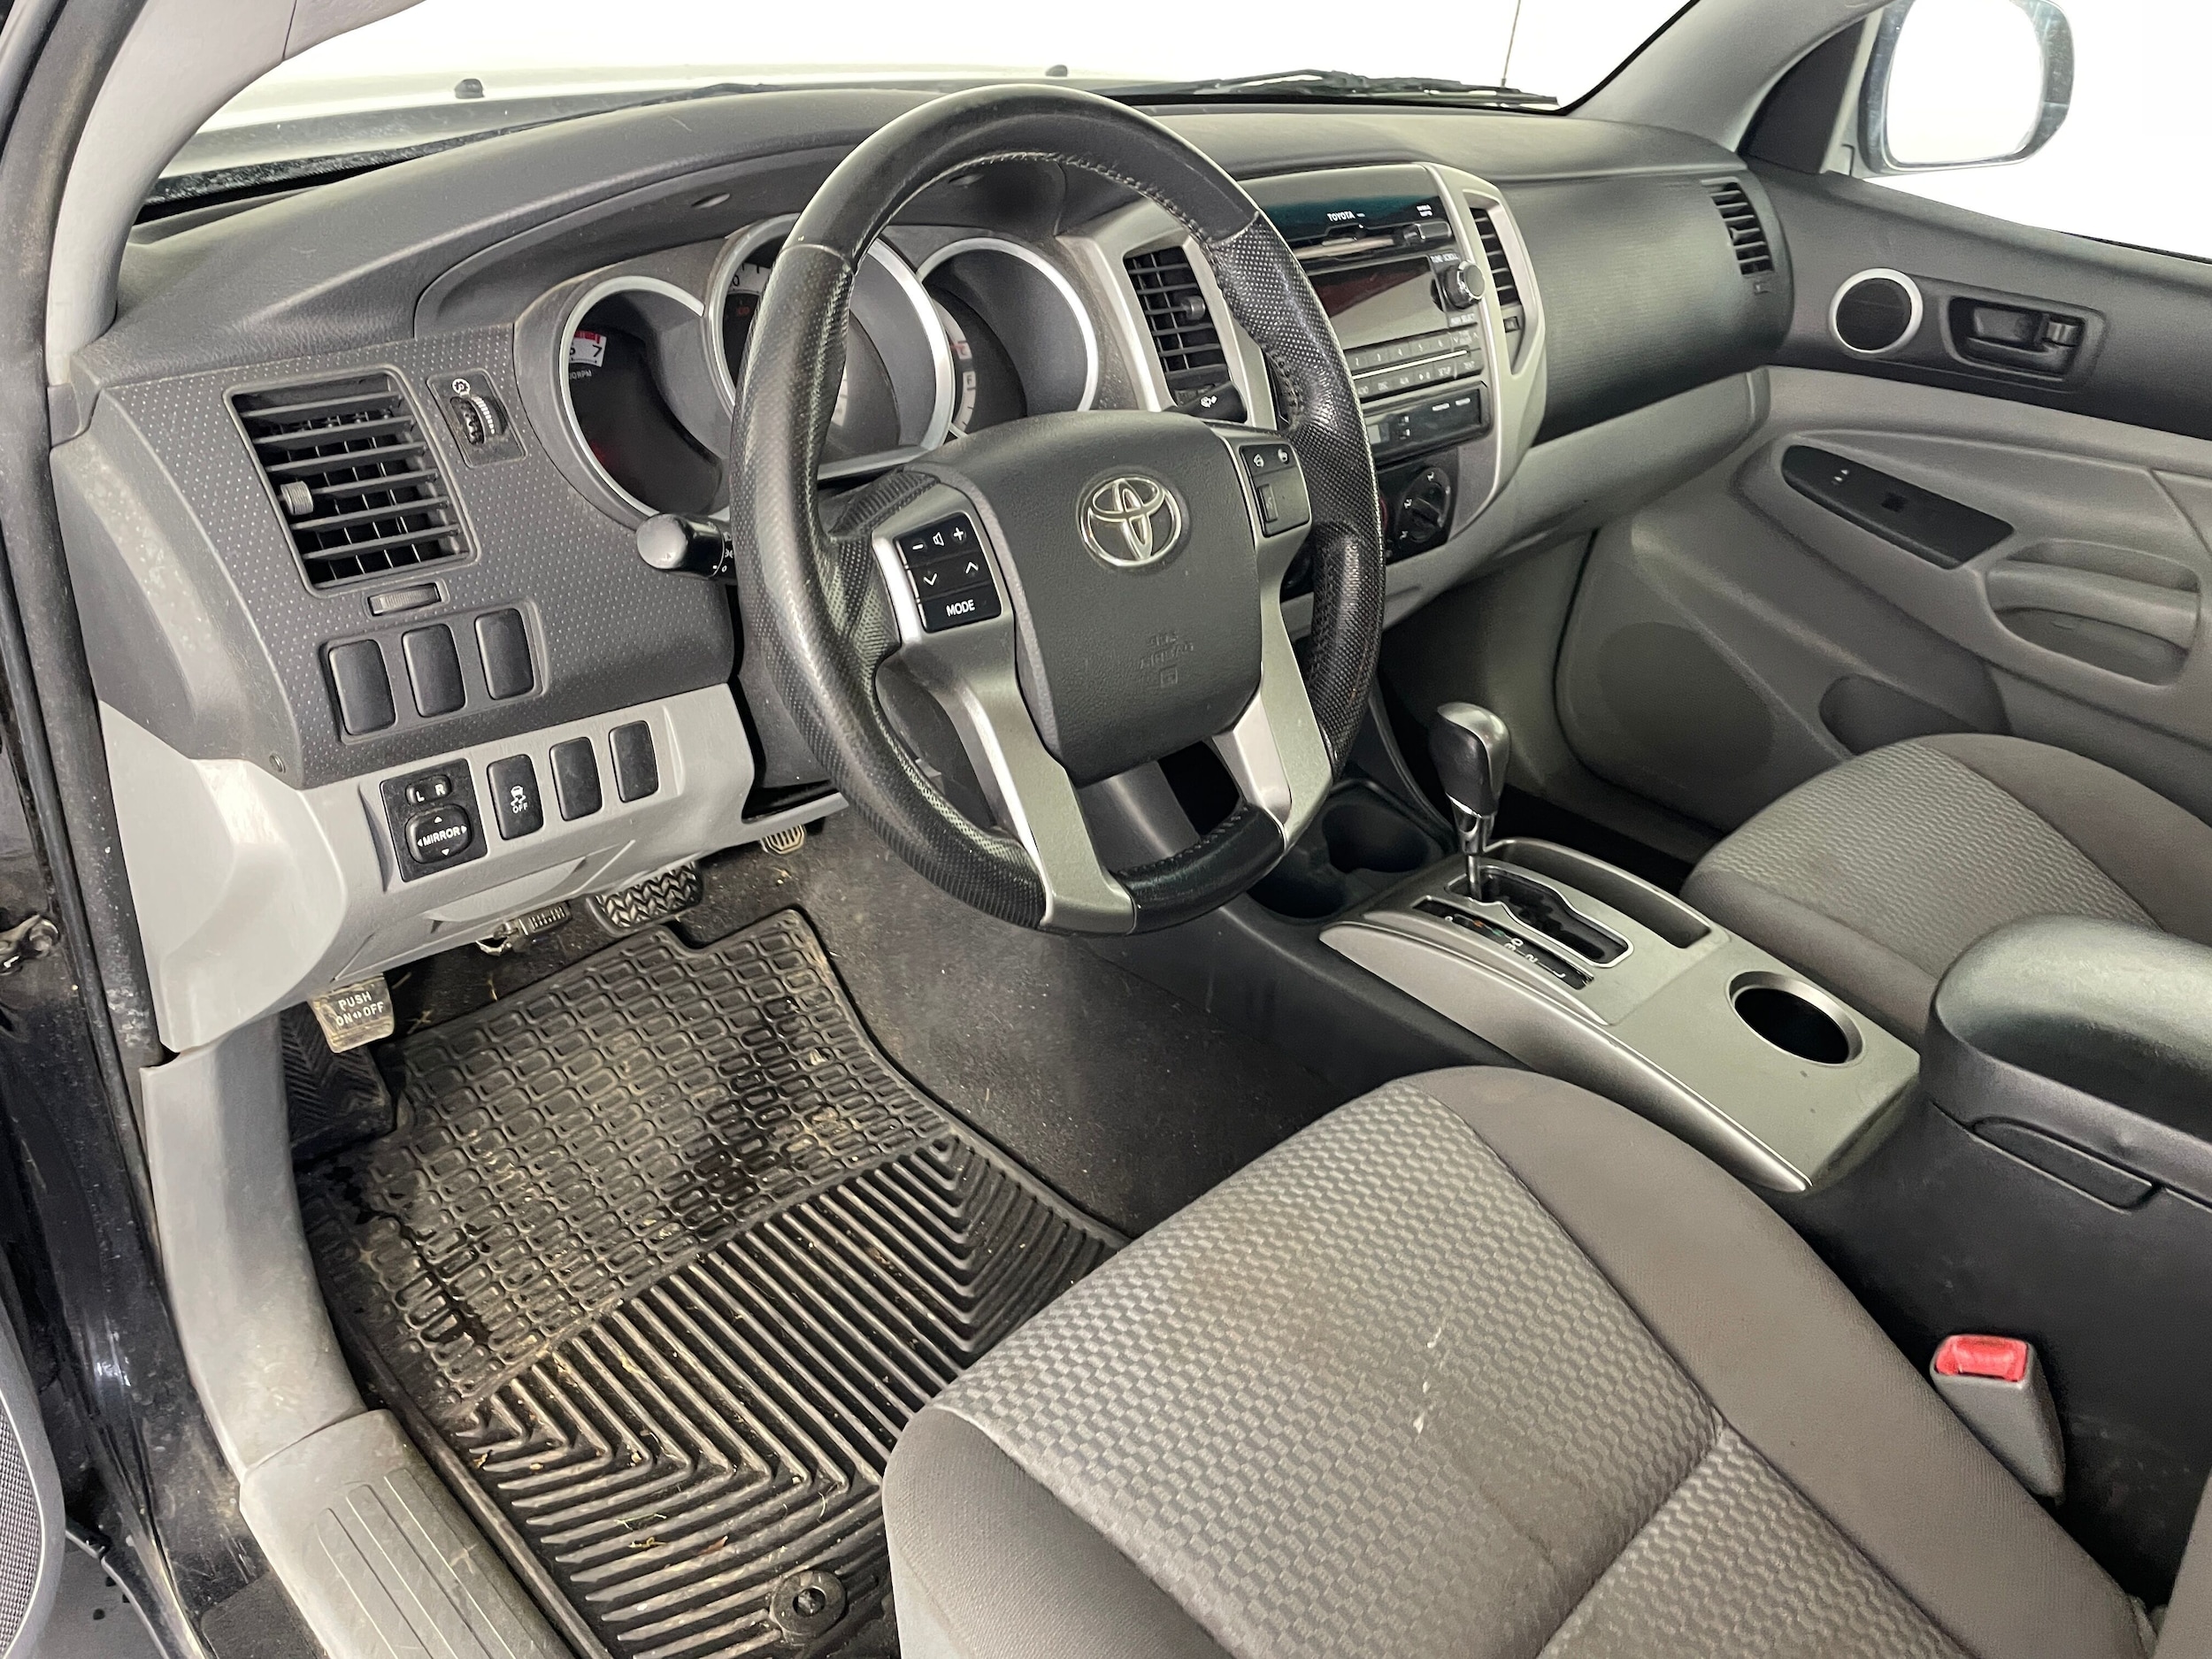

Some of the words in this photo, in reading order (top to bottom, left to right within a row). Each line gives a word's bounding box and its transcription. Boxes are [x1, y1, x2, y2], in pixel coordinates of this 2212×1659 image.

[1327, 211, 1356, 221] TOYOTA
[592, 344, 603, 357] 7
[946, 599, 976, 618] MODE
[416, 791, 425, 803] L
[435, 783, 446, 796] R
[512, 803, 528, 814] OFF
[422, 826, 462, 847] MIRROR
[1525, 953, 1539, 964] 2
[338, 991, 373, 1012] PUSH
[335, 1012, 353, 1027] ON
[363, 1001, 384, 1018] OFF
